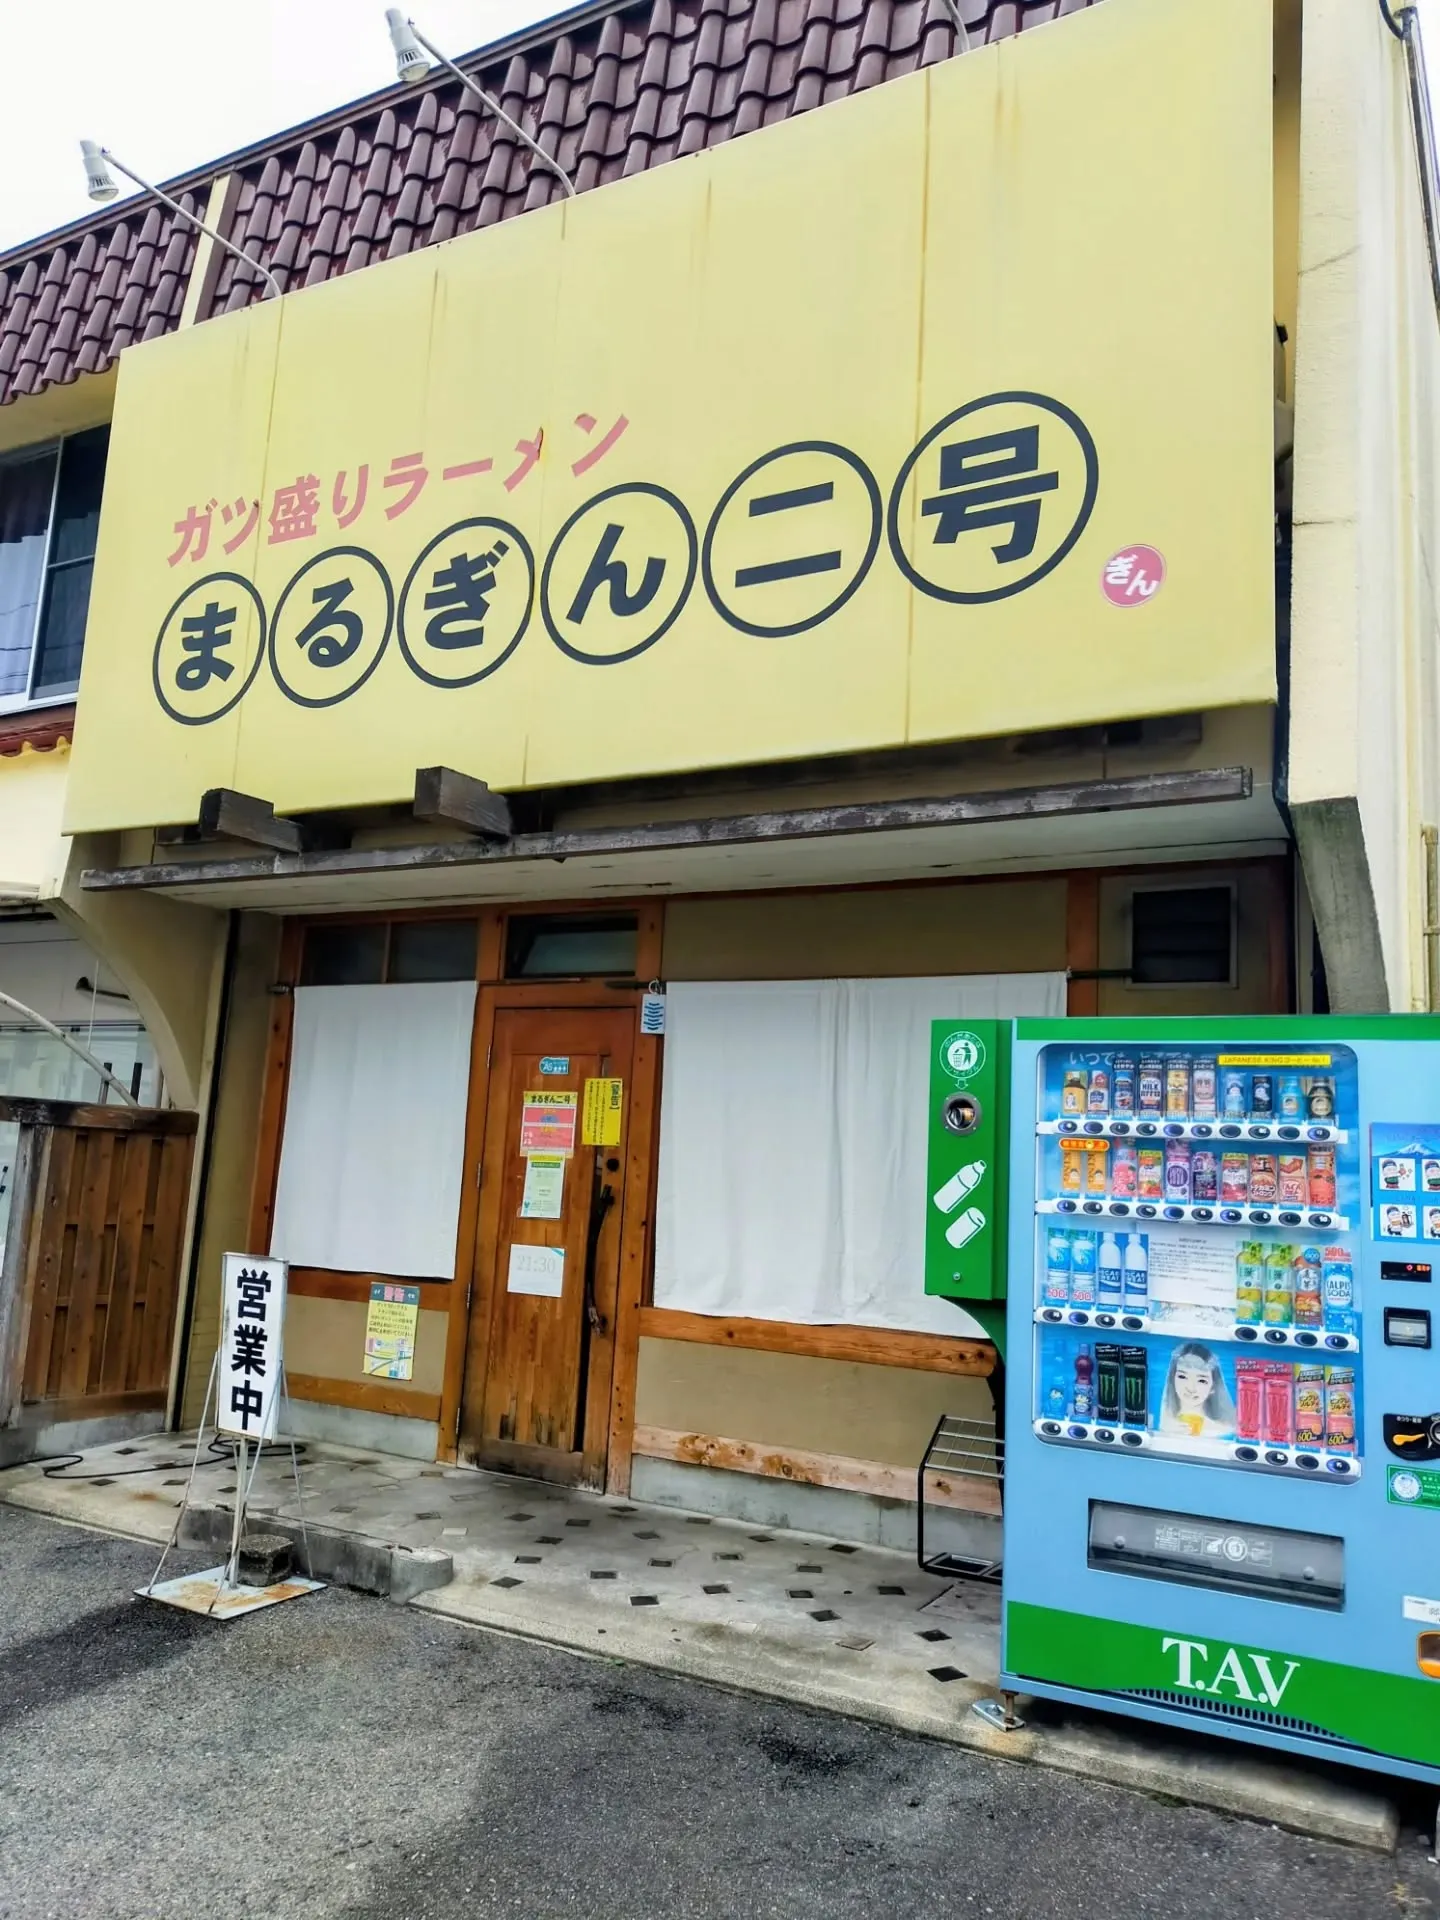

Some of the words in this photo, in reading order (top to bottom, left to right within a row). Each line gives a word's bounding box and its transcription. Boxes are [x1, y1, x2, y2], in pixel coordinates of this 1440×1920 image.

[166, 412, 629, 568] ガツ盛りラーメン
[174, 424, 1060, 692] まるぎん二号
[1104, 552, 1158, 598] ぎん
[231, 1267, 272, 1431] 営業中
